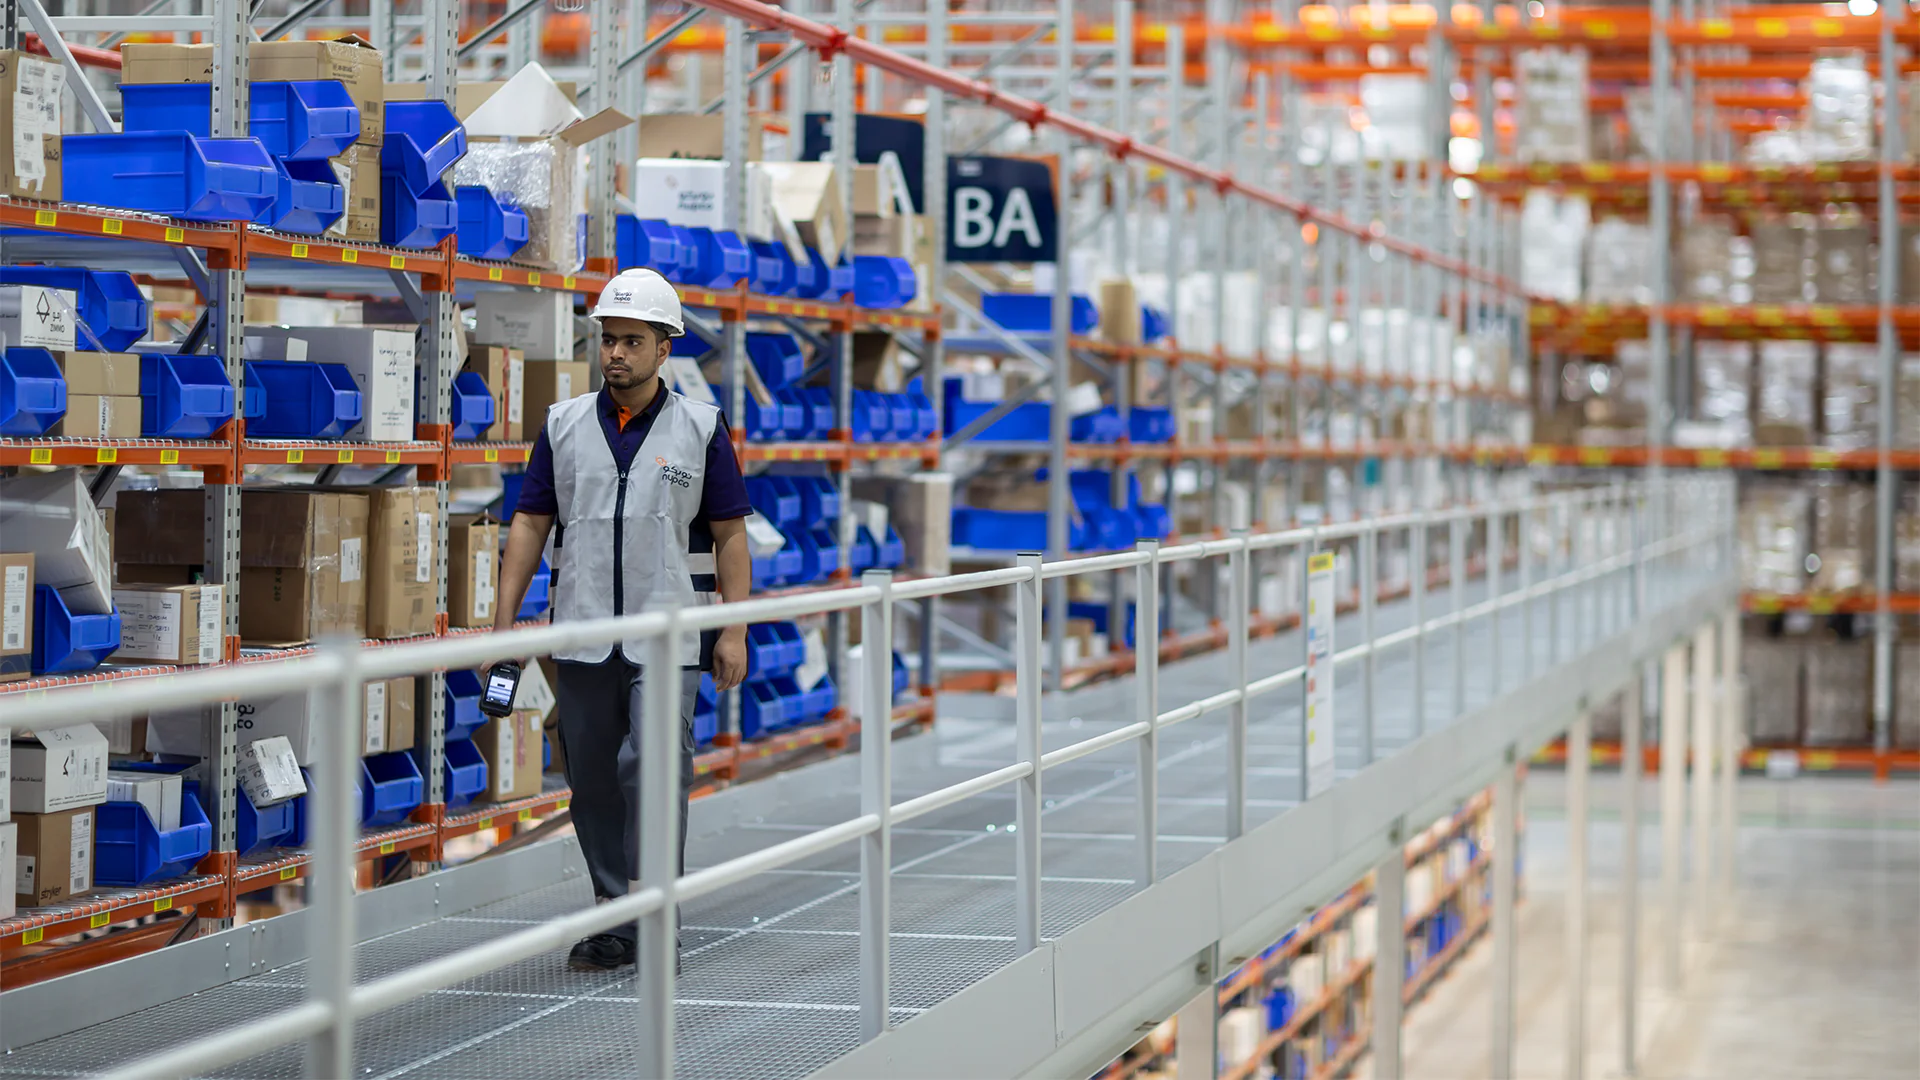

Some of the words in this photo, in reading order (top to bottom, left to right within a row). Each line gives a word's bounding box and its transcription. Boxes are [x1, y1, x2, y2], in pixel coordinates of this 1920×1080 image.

[954, 186, 1043, 248] BA
[662, 473, 690, 489] nupco
[40, 886, 62, 900] stryker
